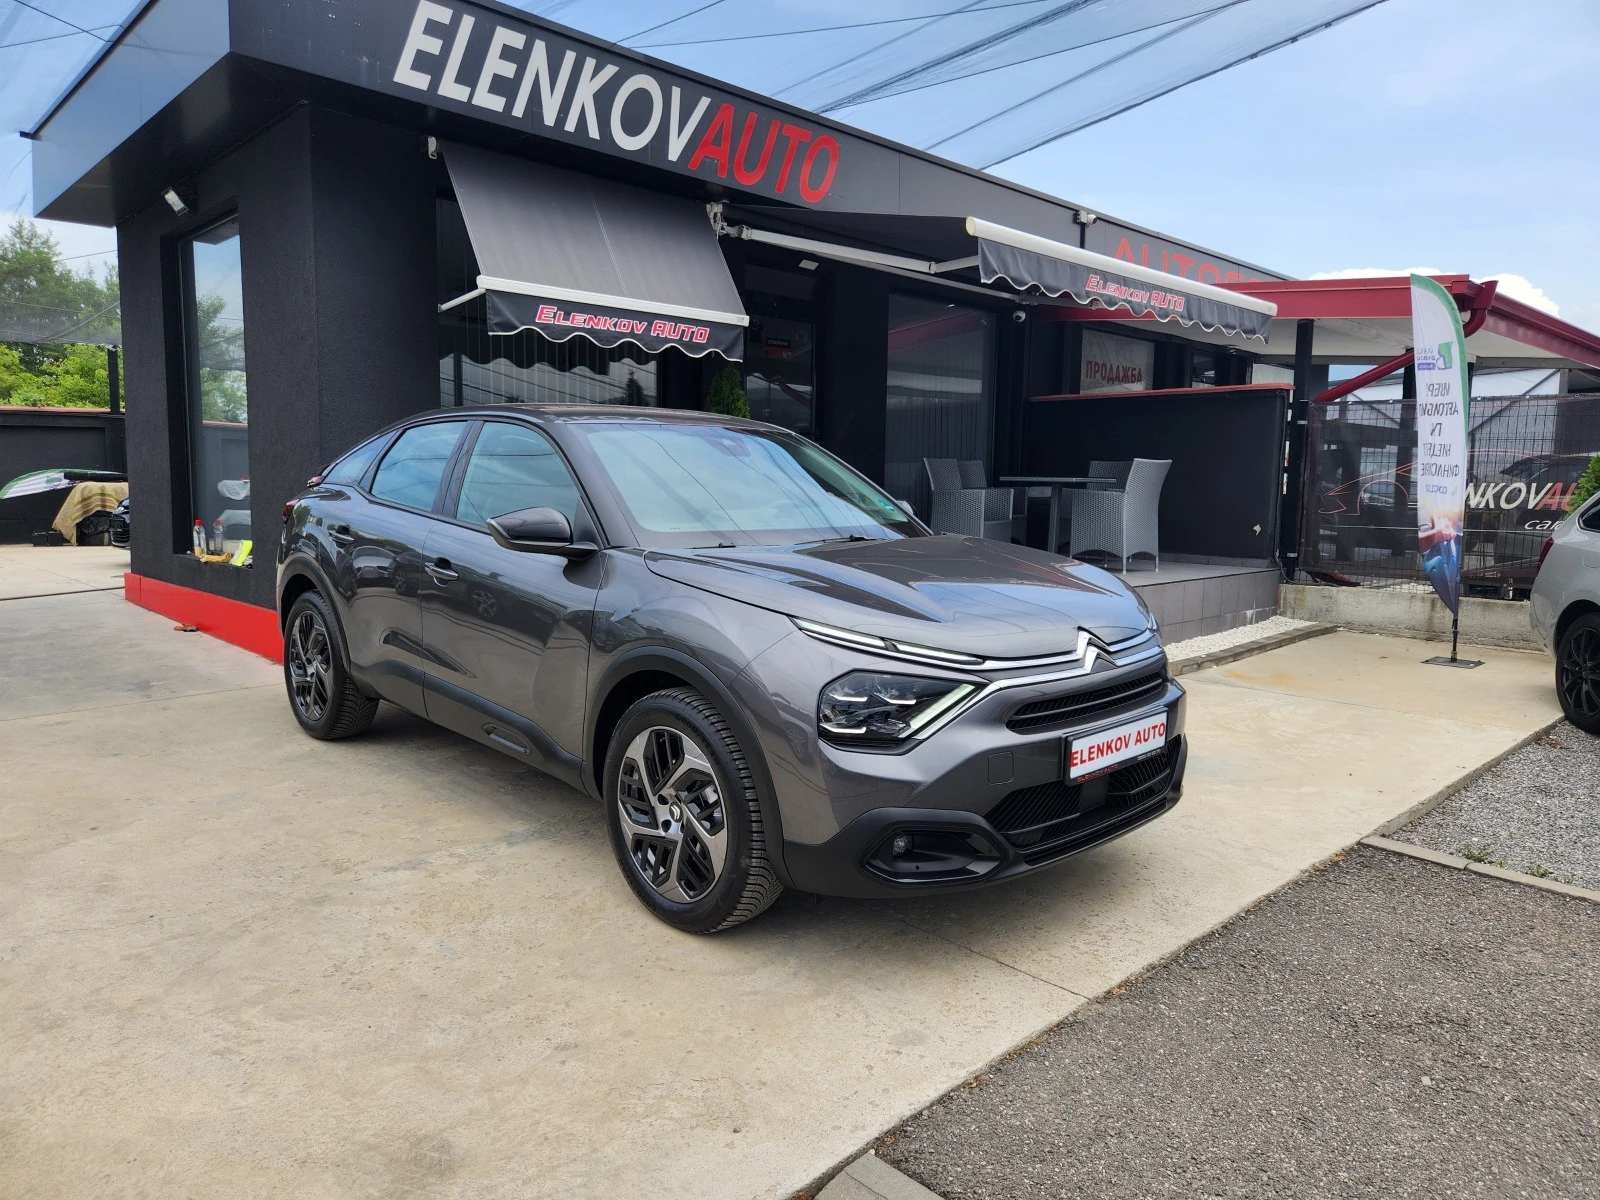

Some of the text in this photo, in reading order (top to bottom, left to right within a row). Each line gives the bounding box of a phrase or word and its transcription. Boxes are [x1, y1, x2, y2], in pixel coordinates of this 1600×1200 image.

[651, 320, 711, 344] AUTO
[1085, 360, 1143, 385] ПРОДАЖБА
[1070, 733, 1132, 768] ELENKOV
[1134, 722, 1166, 746] AUTO
